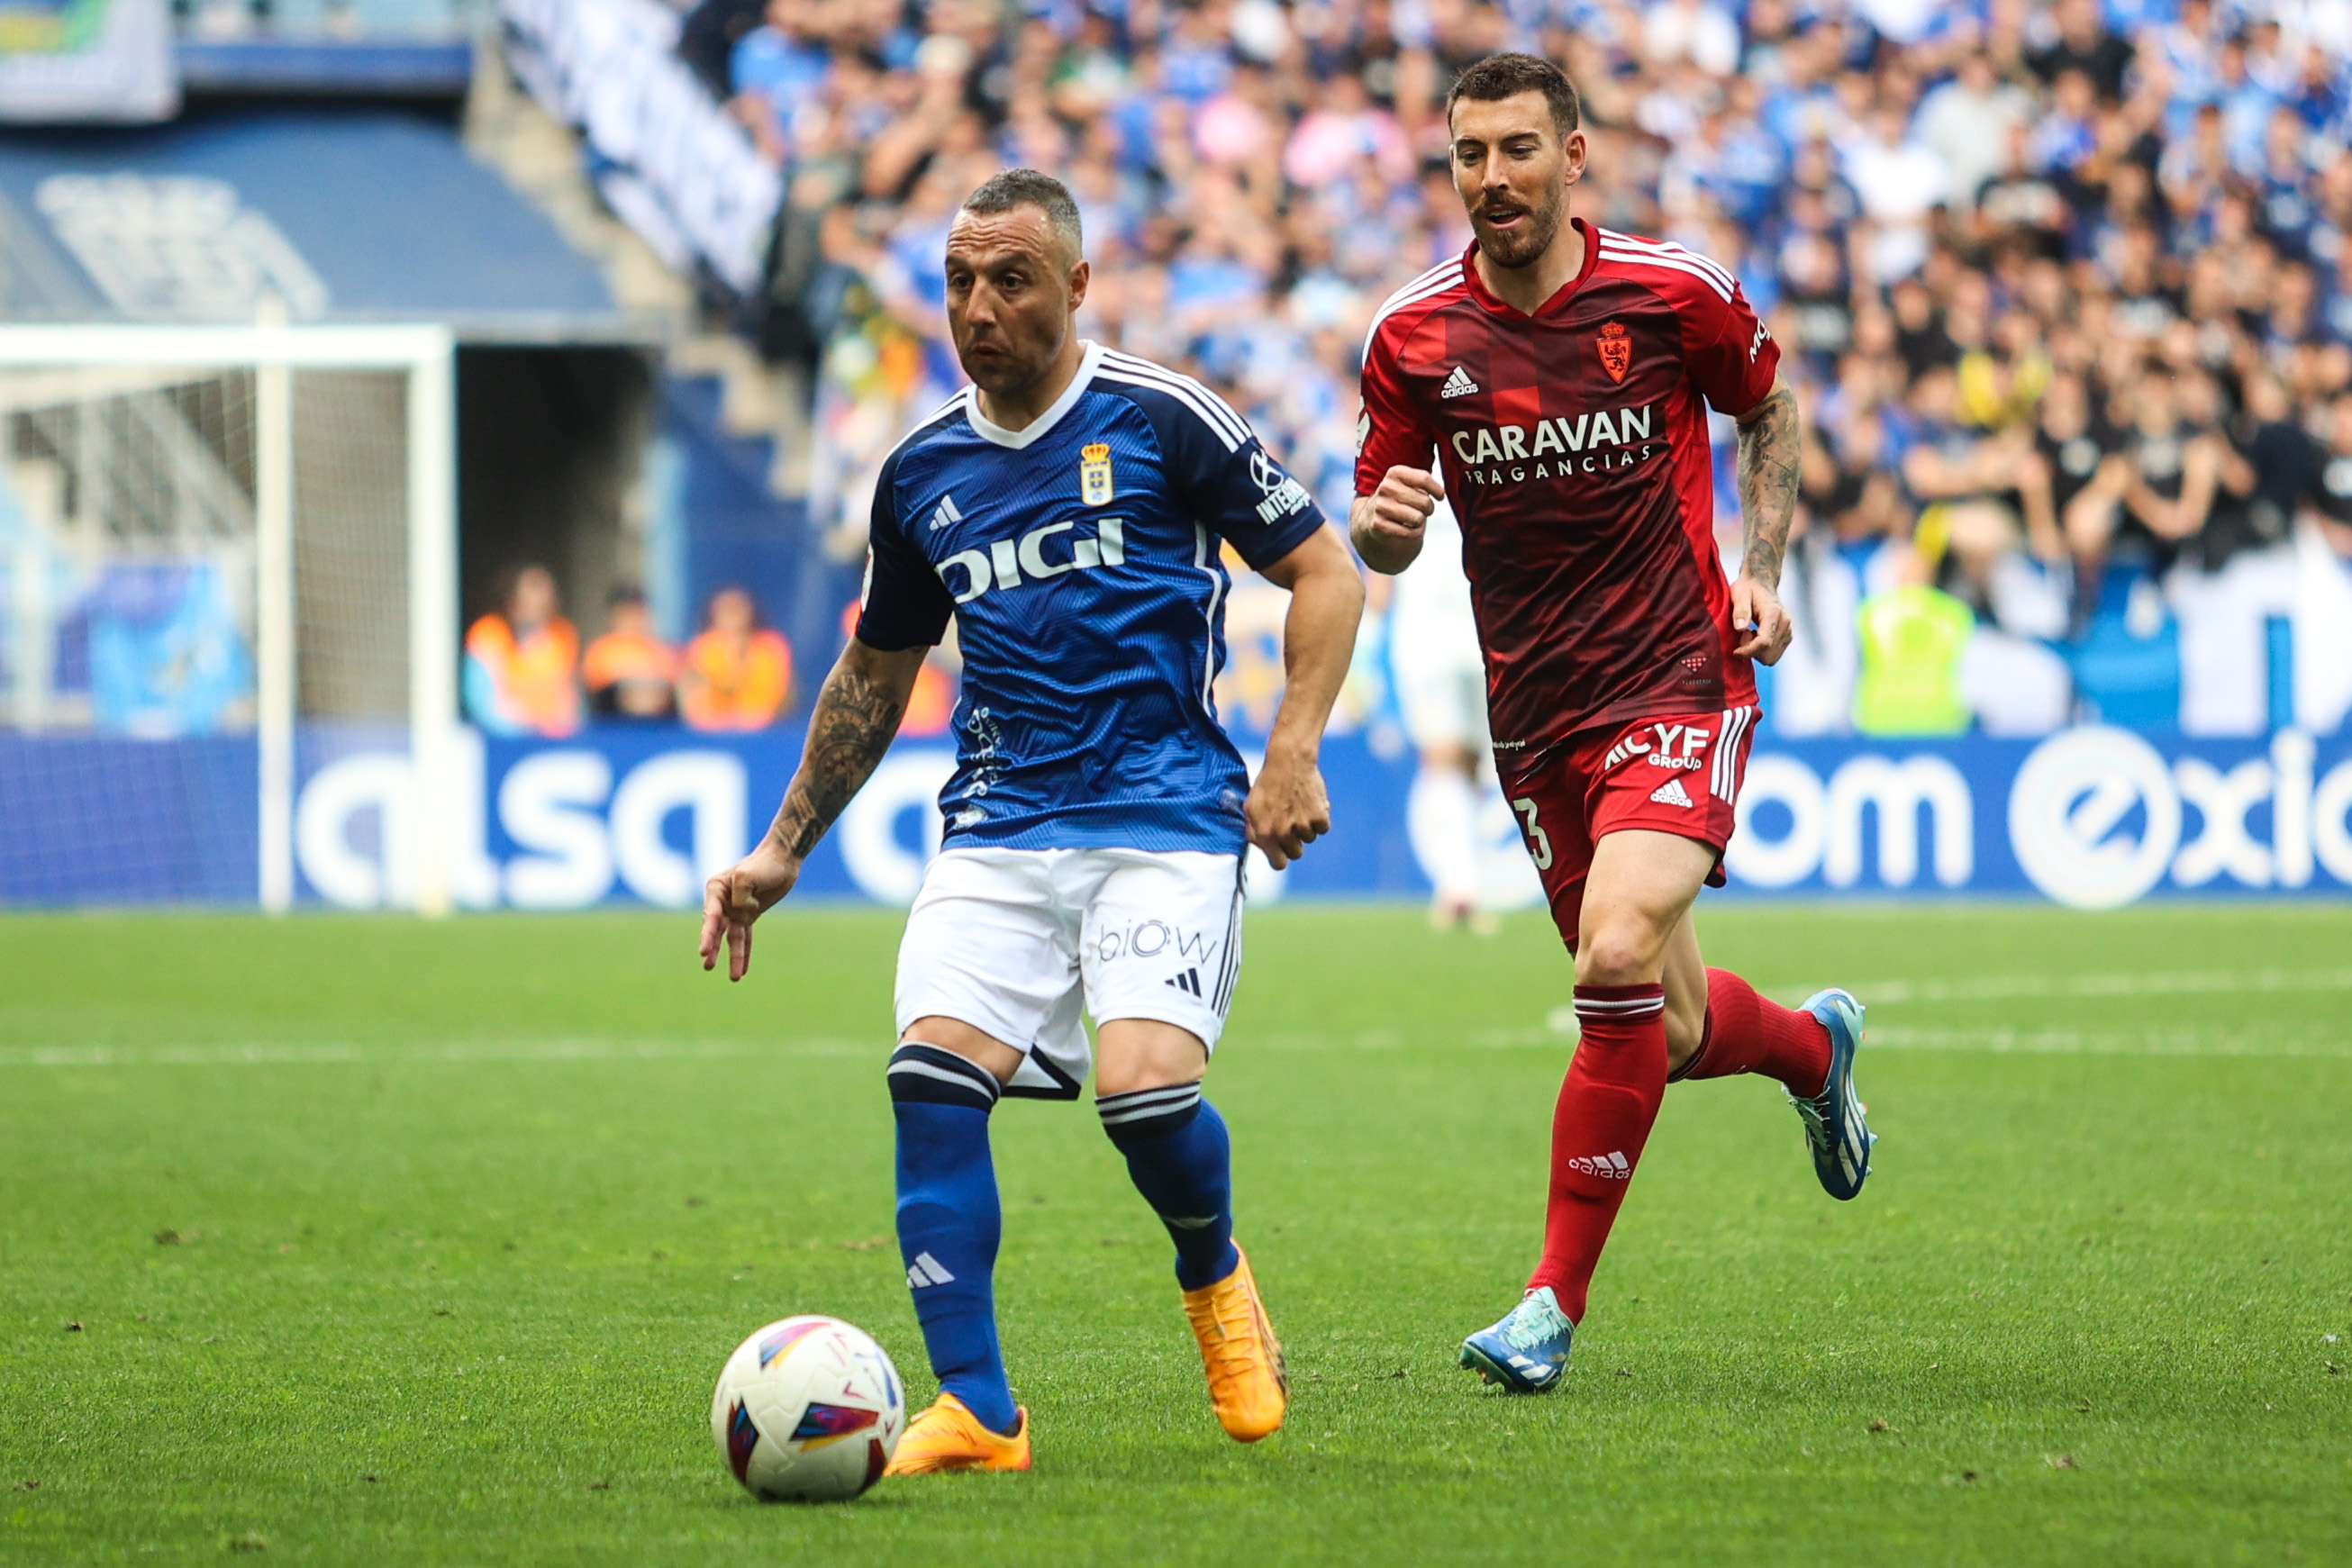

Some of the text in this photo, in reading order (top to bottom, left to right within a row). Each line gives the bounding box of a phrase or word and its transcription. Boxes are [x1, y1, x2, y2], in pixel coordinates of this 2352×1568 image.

[1440, 381, 1478, 399] adidas
[1452, 405, 1650, 465] CARAVAN
[1465, 445, 1650, 485] FRAGANCIAS
[933, 518, 1125, 604] DIGI
[1648, 753, 1703, 771] GROUP
[296, 724, 749, 910] alsa
[1649, 793, 1694, 808] adidas
[1513, 797, 1553, 871] 3
[1568, 1156, 1631, 1180] adidas
